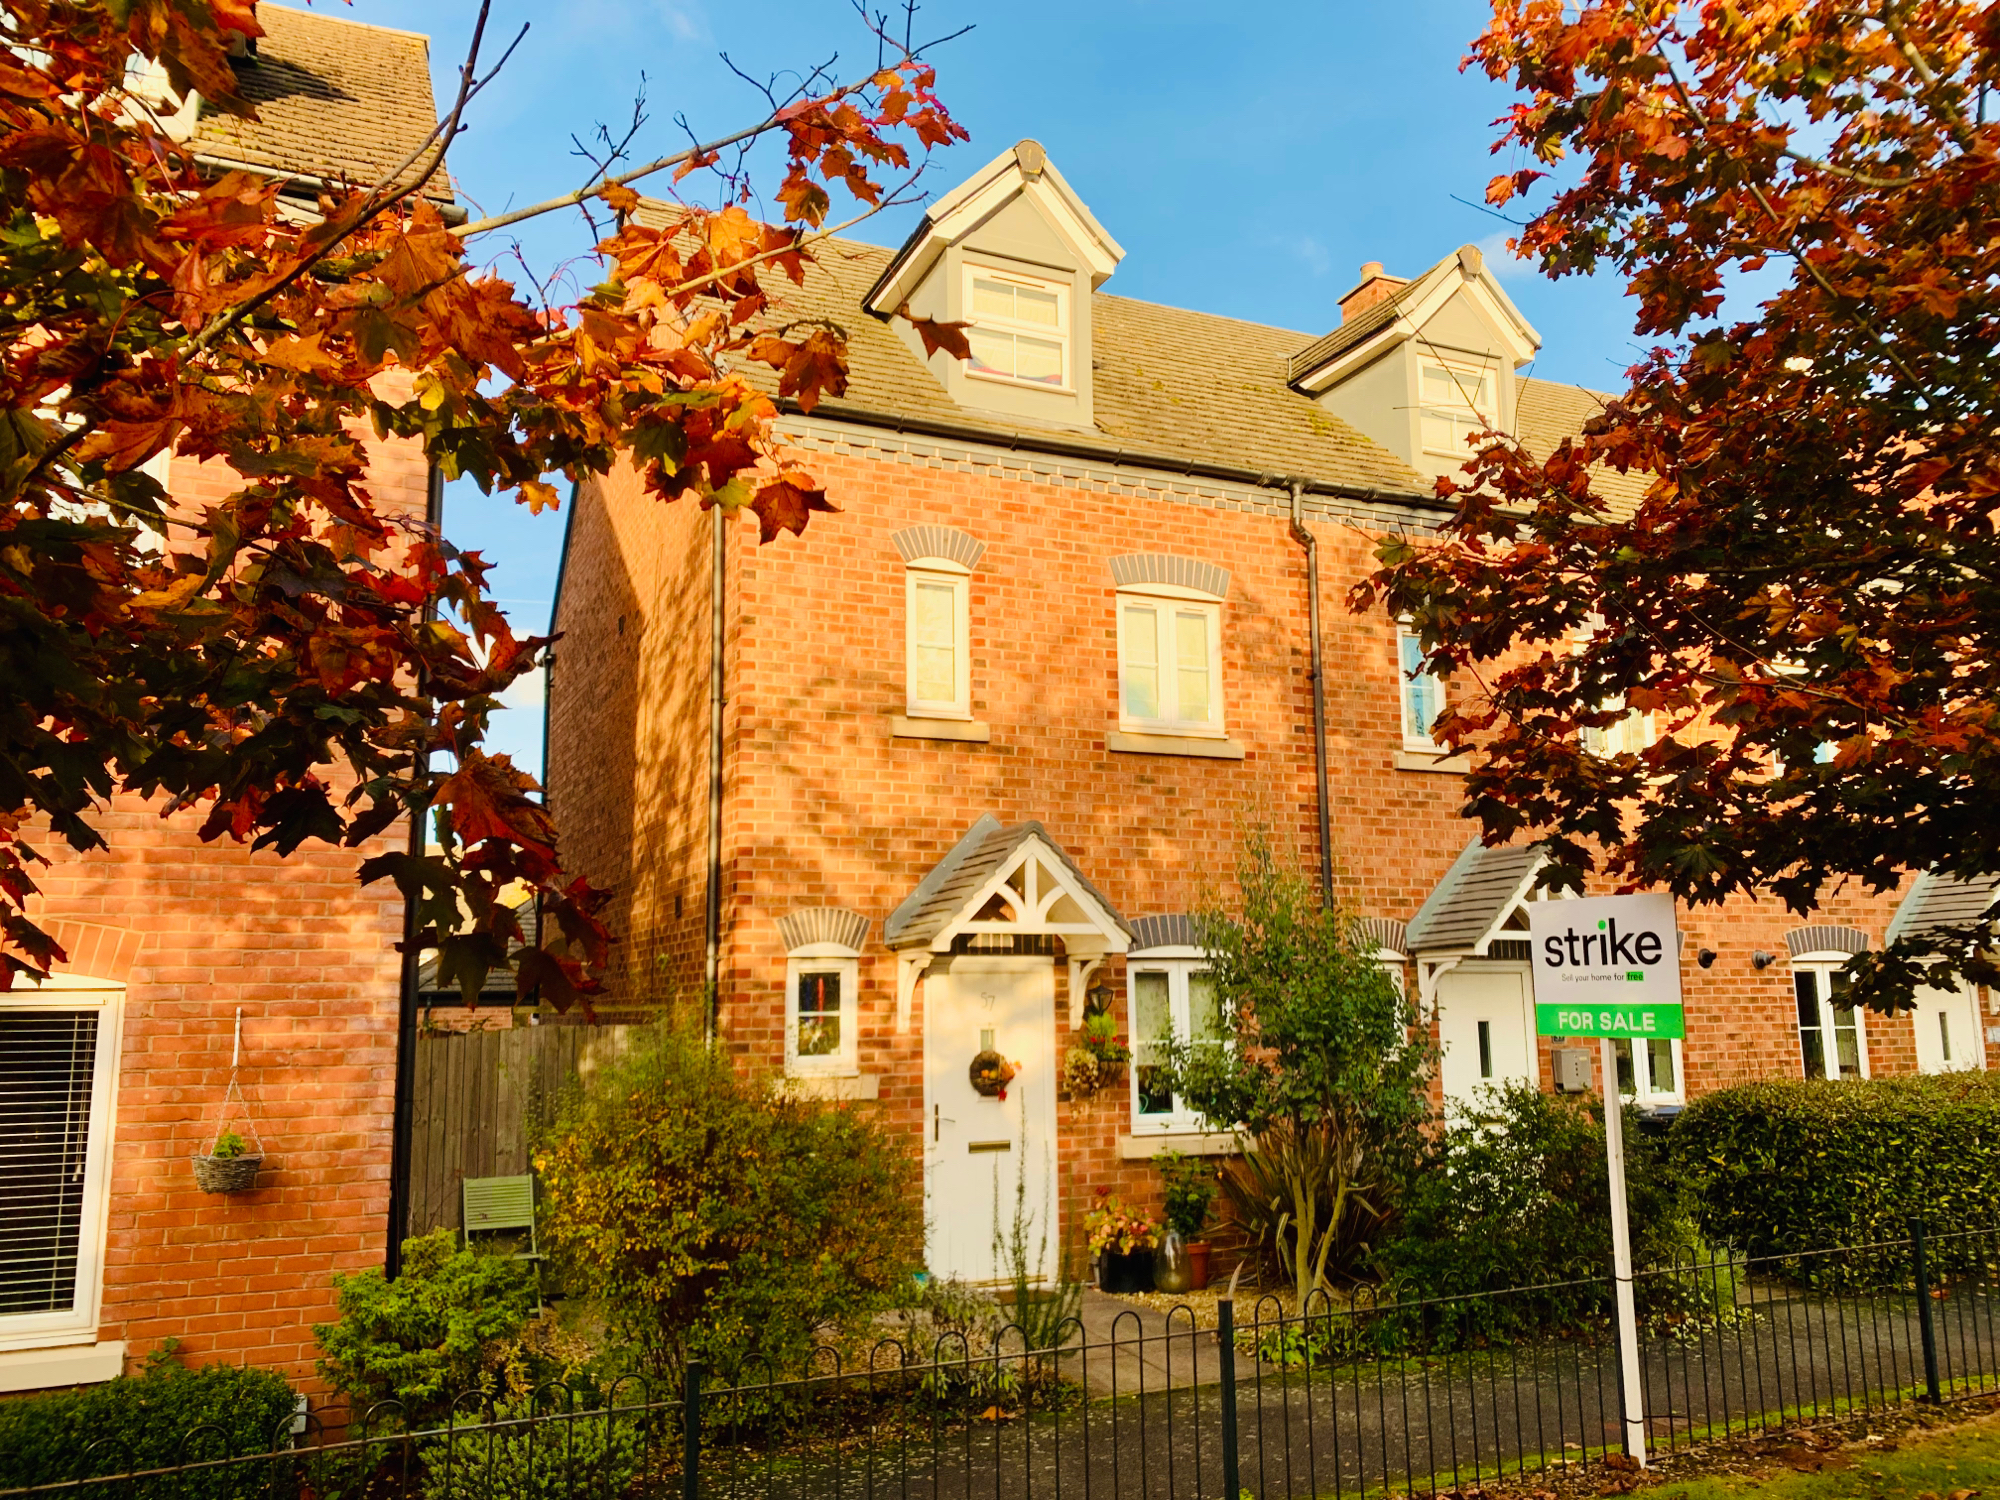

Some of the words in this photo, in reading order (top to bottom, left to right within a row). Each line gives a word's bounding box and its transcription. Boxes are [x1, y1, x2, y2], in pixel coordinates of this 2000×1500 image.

[1545, 918, 1662, 967] strike
[1562, 973, 1574, 982] Sell
[1575, 974, 1589, 983] your
[1591, 973, 1612, 982] home
[1614, 972, 1624, 981] for
[1627, 972, 1643, 981] free
[980, 991, 995, 1011] 57
[1558, 1011, 1594, 1030] FOR
[1600, 1012, 1656, 1031] SALE
